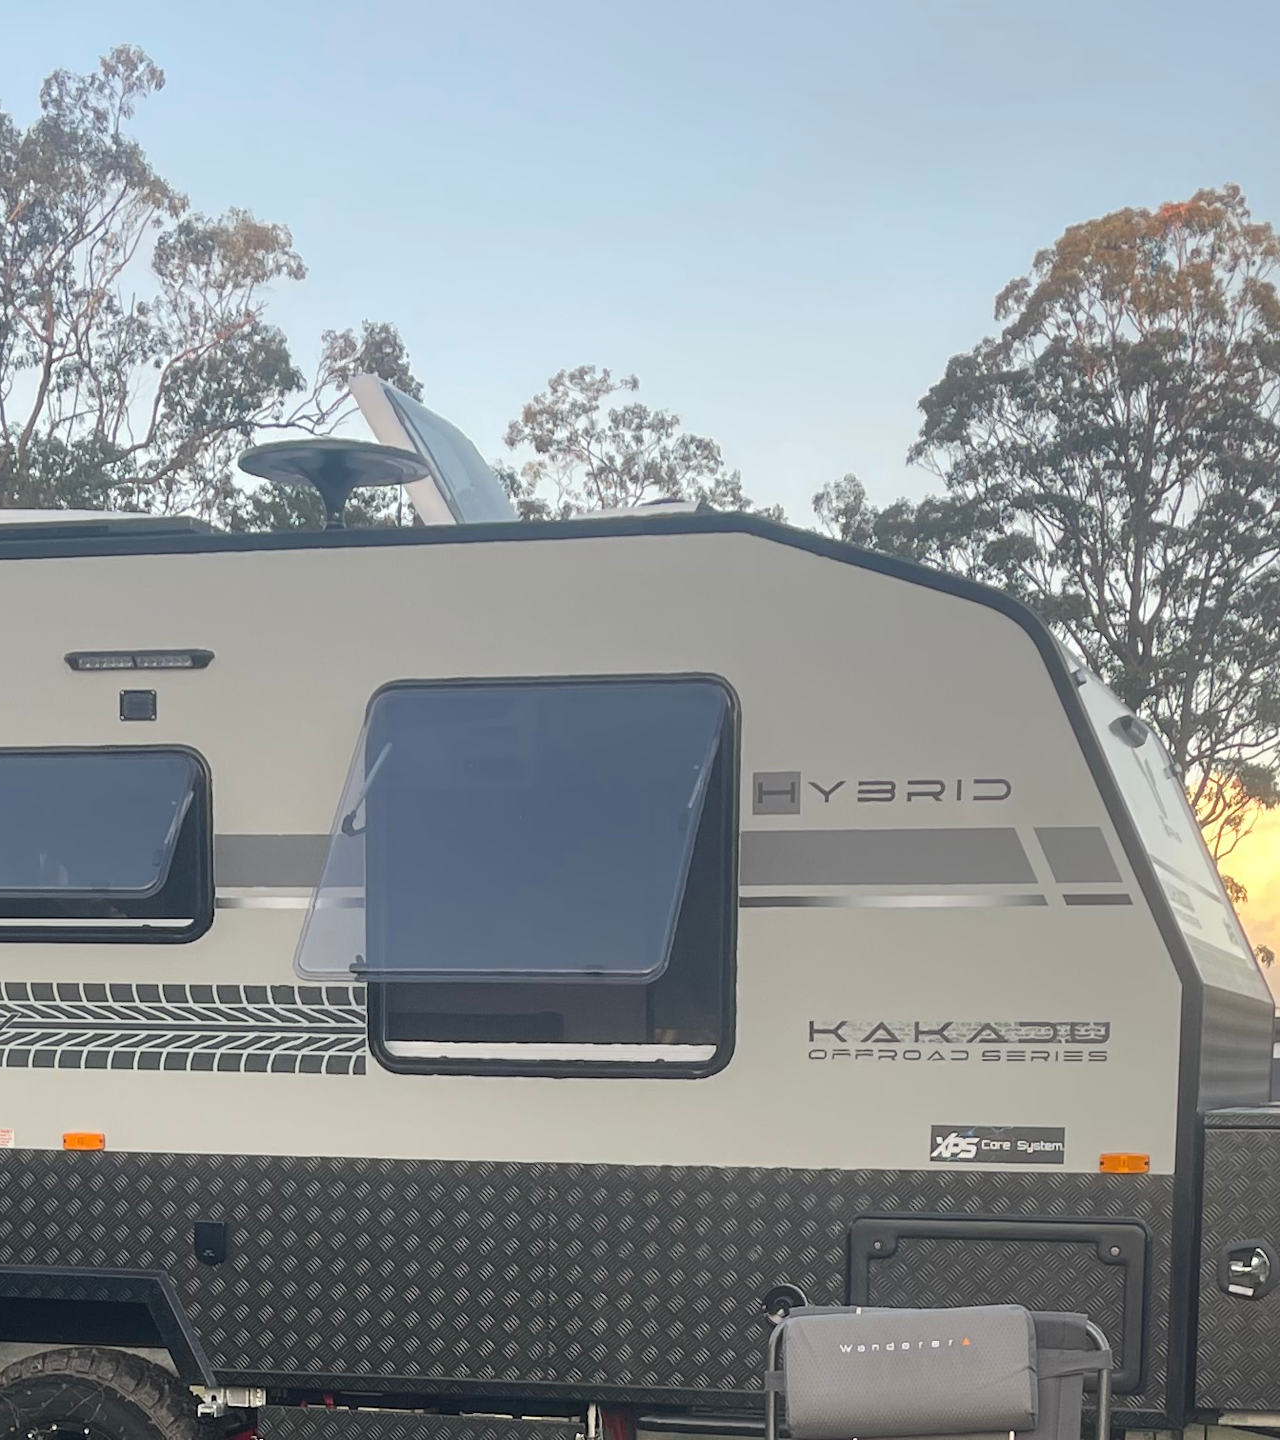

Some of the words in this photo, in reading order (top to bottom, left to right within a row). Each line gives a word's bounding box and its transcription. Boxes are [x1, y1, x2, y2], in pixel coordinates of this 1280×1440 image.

[756, 778, 1012, 803] HYBRID
[808, 1019, 1111, 1045] KAKADU
[808, 1048, 969, 1062] OFFROAD
[981, 1050, 1108, 1062] SERIES
[930, 1132, 980, 1159] XPS
[1016, 1140, 1063, 1153] System
[839, 1338, 953, 1353] Wanderer
